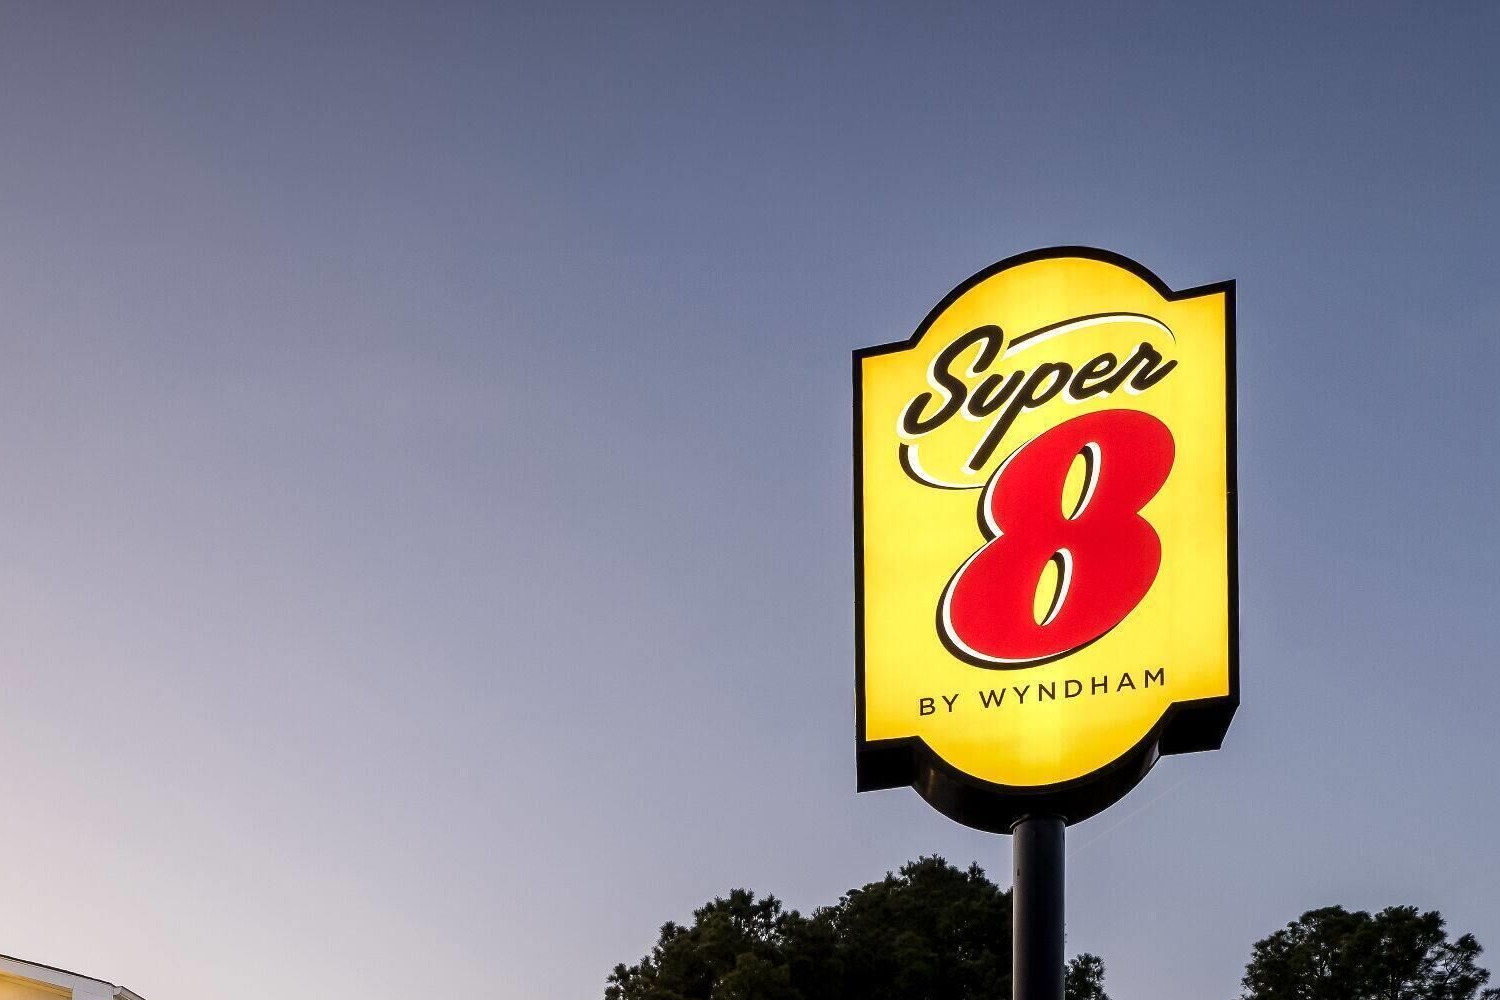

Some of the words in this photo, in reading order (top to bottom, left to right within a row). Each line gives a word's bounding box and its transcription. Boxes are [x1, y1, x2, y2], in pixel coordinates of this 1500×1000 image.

[900, 324, 1178, 472] Super
[936, 408, 1176, 671] 8
[918, 692, 960, 717] BY
[978, 667, 1167, 709] WYNDHAM
